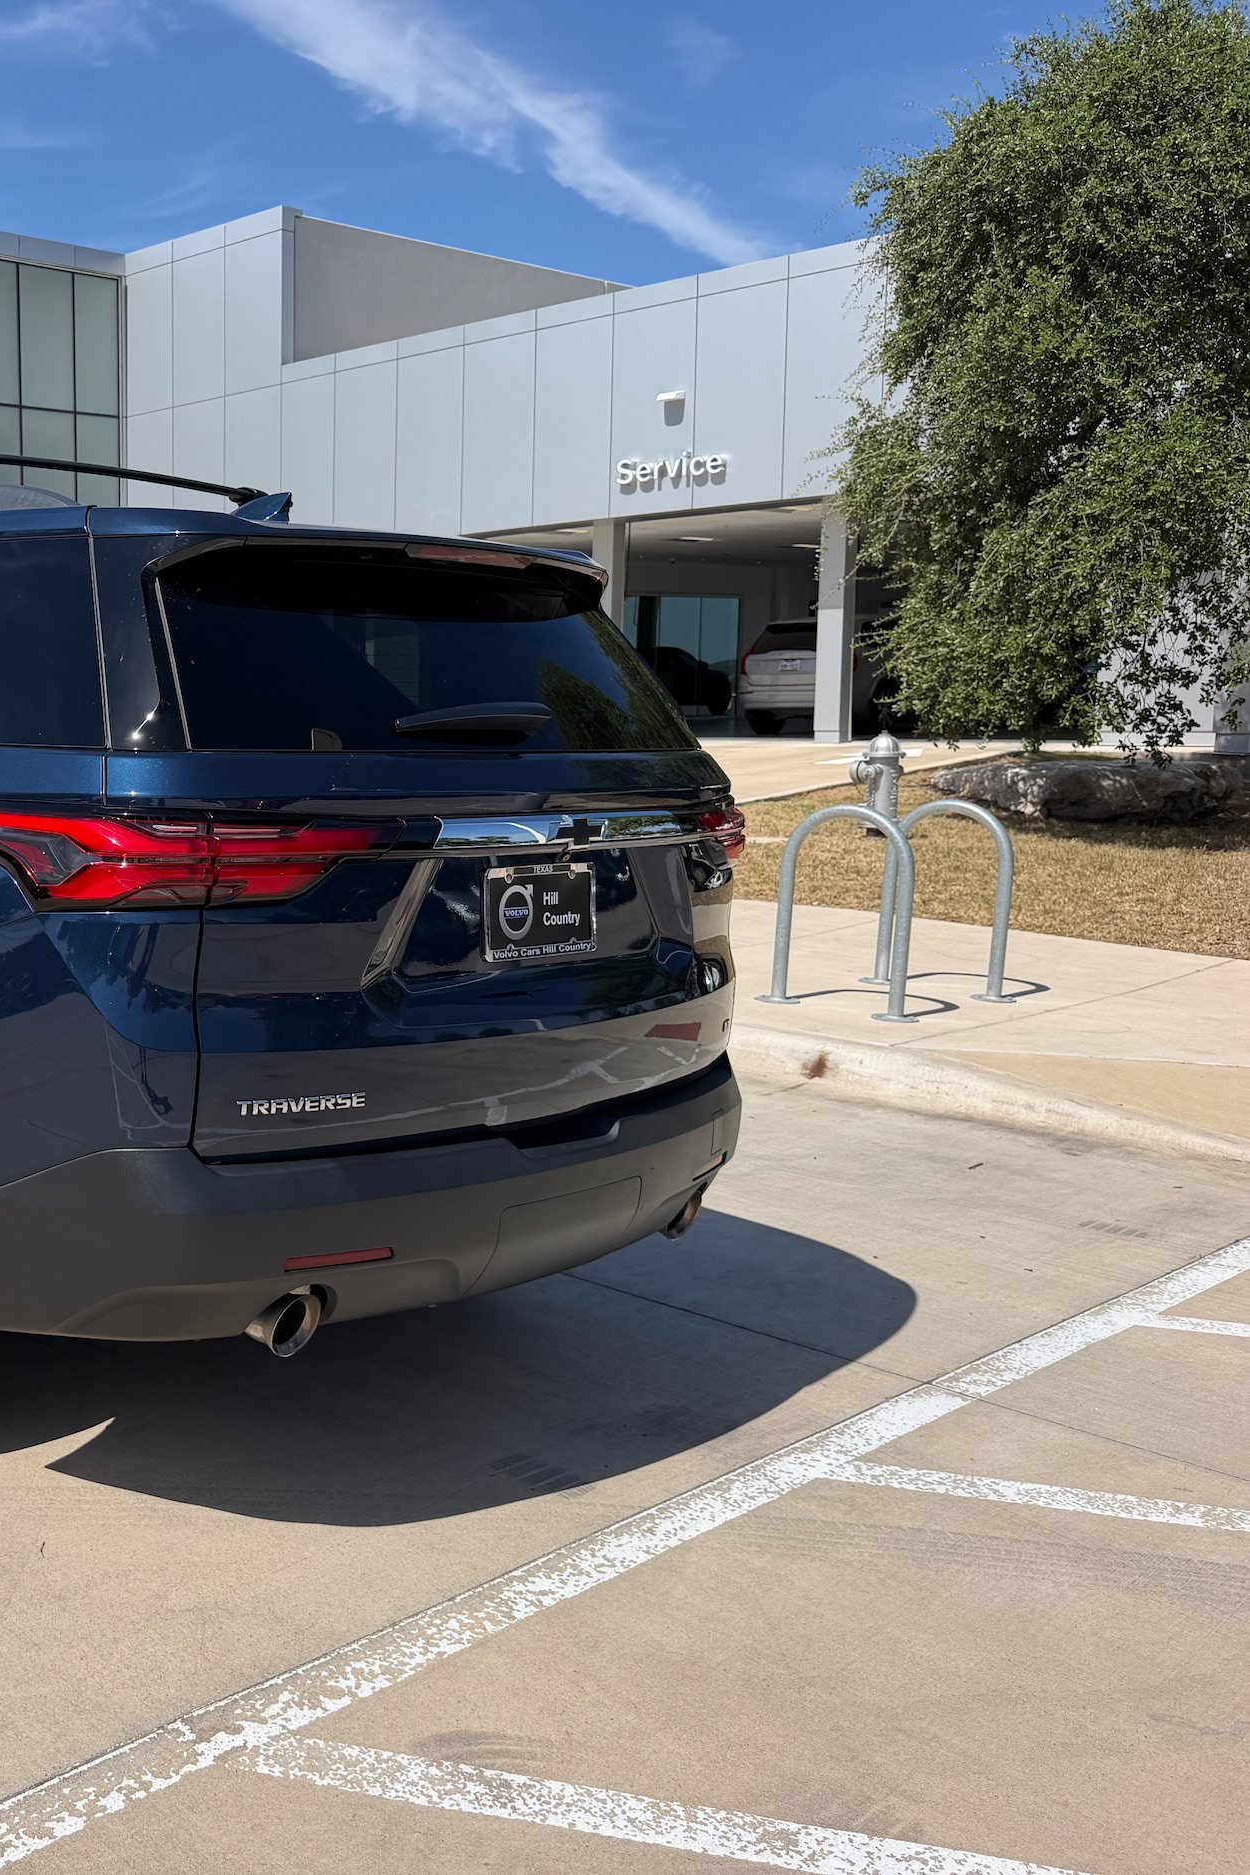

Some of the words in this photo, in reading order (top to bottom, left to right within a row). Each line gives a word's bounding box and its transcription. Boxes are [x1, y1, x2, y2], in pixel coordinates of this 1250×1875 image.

[616, 450, 726, 485] Service
[533, 865, 553, 873] TEXAS
[543, 891, 559, 905] Hill
[504, 908, 529, 917] VOLVO
[543, 911, 580, 926] Country
[493, 950, 518, 959] Volvo
[520, 947, 541, 956] Cars
[543, 944, 557, 954] Hill
[558, 942, 591, 953] Country
[236, 1091, 366, 1116] TRAVERSE
